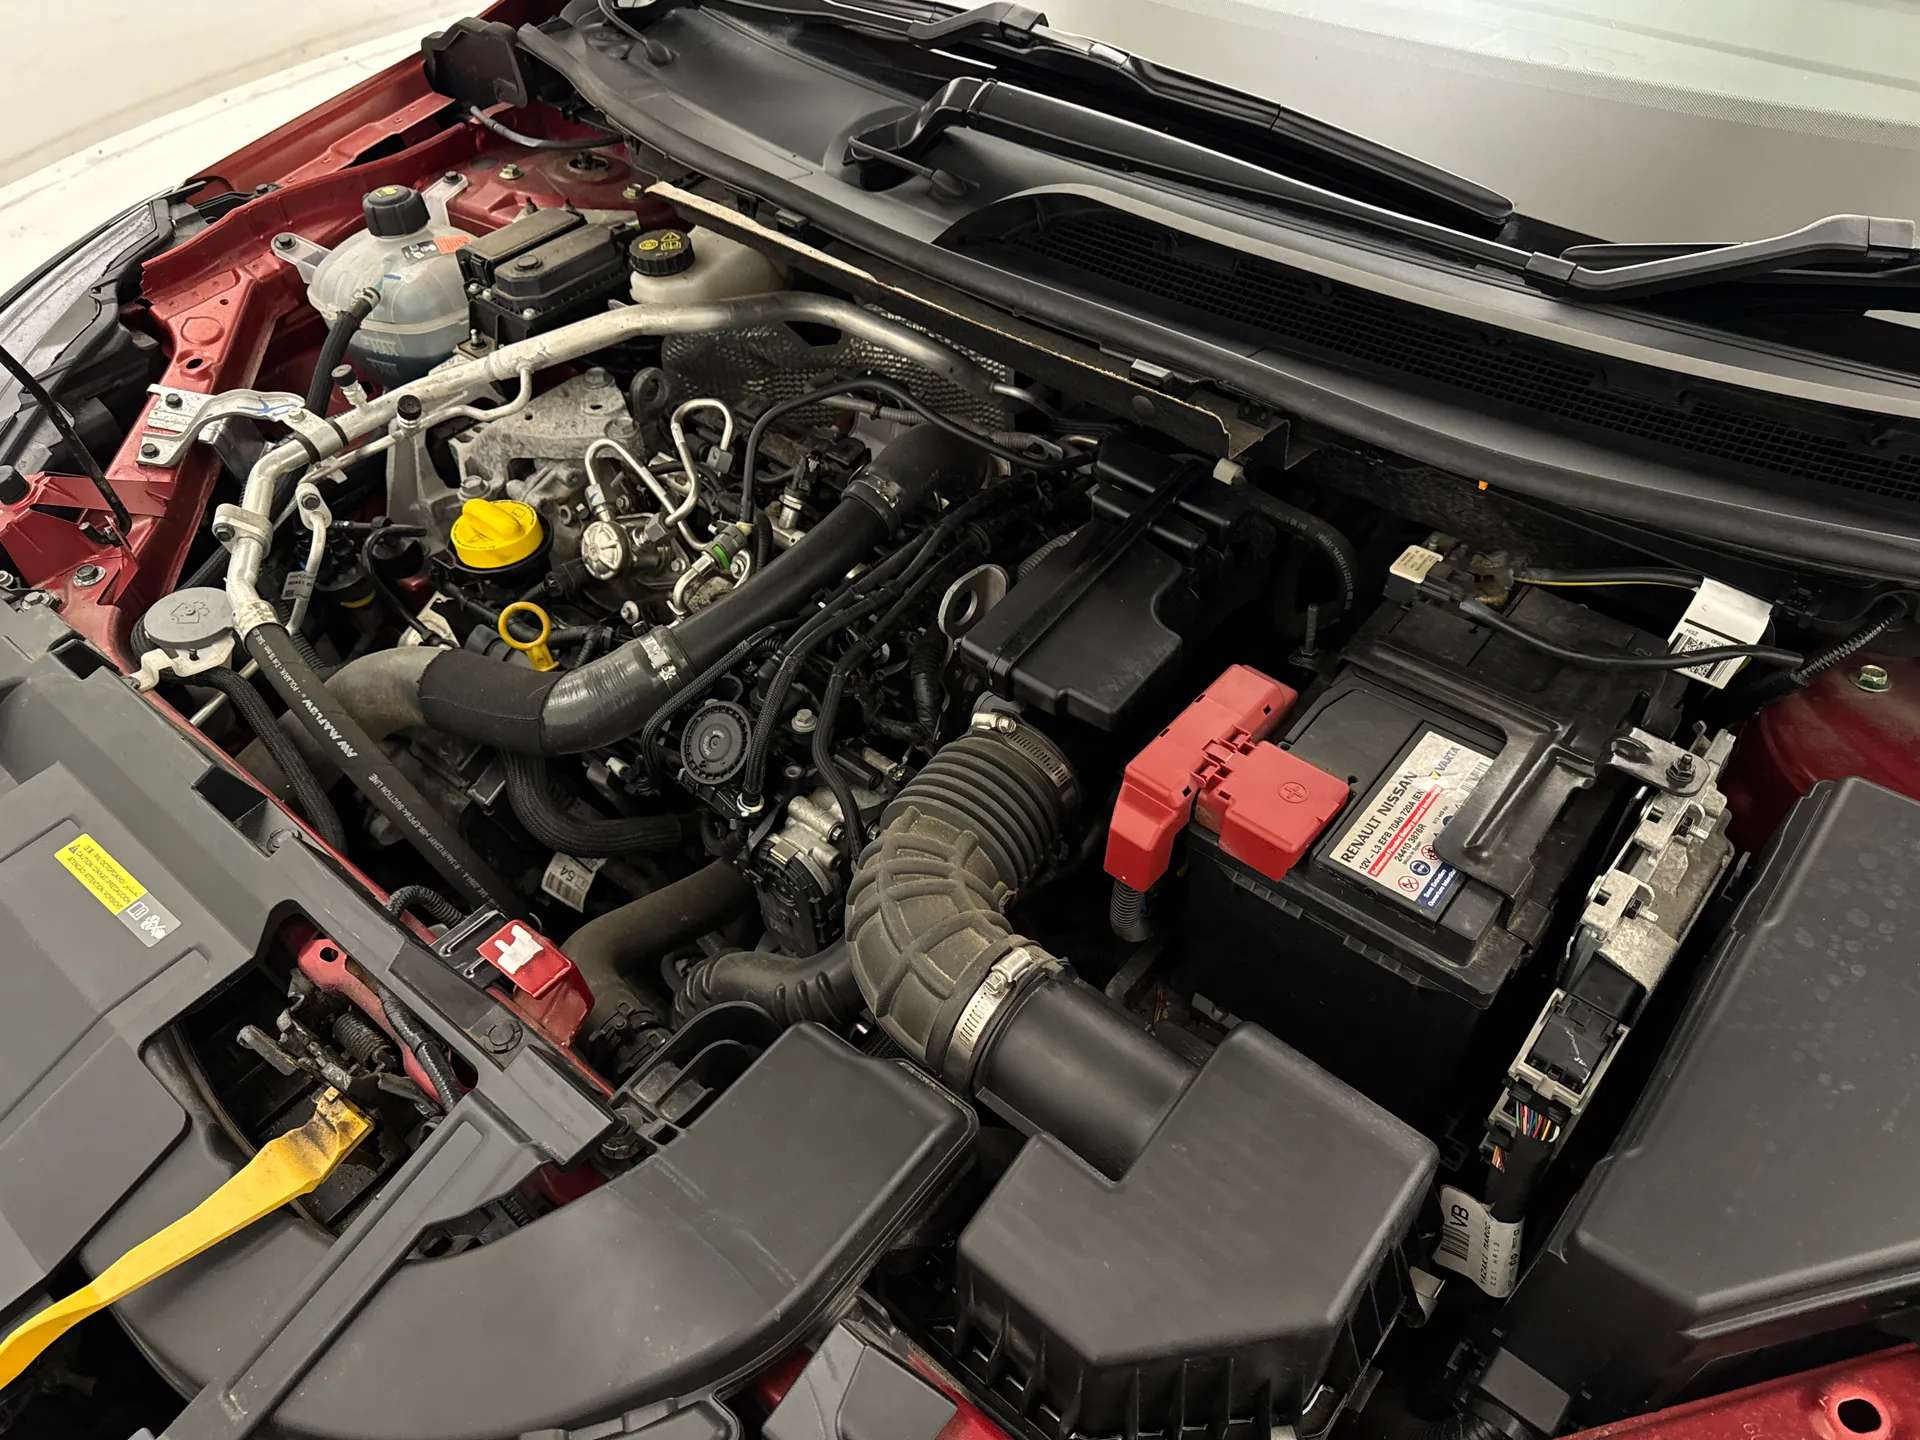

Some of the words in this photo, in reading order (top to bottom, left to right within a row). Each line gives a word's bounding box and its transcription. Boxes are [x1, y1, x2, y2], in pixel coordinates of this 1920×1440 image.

[302, 699, 342, 740] MAFLOW
[1434, 746, 1461, 773] VARTA
[368, 773, 384, 789] LINE
[381, 786, 404, 811] SUCTION
[1341, 815, 1383, 863] RENAULT
[1379, 771, 1419, 816] NISSAN
[1359, 860, 1372, 872] 12V
[1373, 842, 1383, 854] L3
[1380, 828, 1394, 847] EFB
[1389, 815, 1404, 832] 70Ah
[1402, 800, 1416, 820] 720A
[1394, 840, 1413, 863] 24410
[1409, 824, 1427, 844] 3876R
[1450, 1204, 1469, 1227] VB
